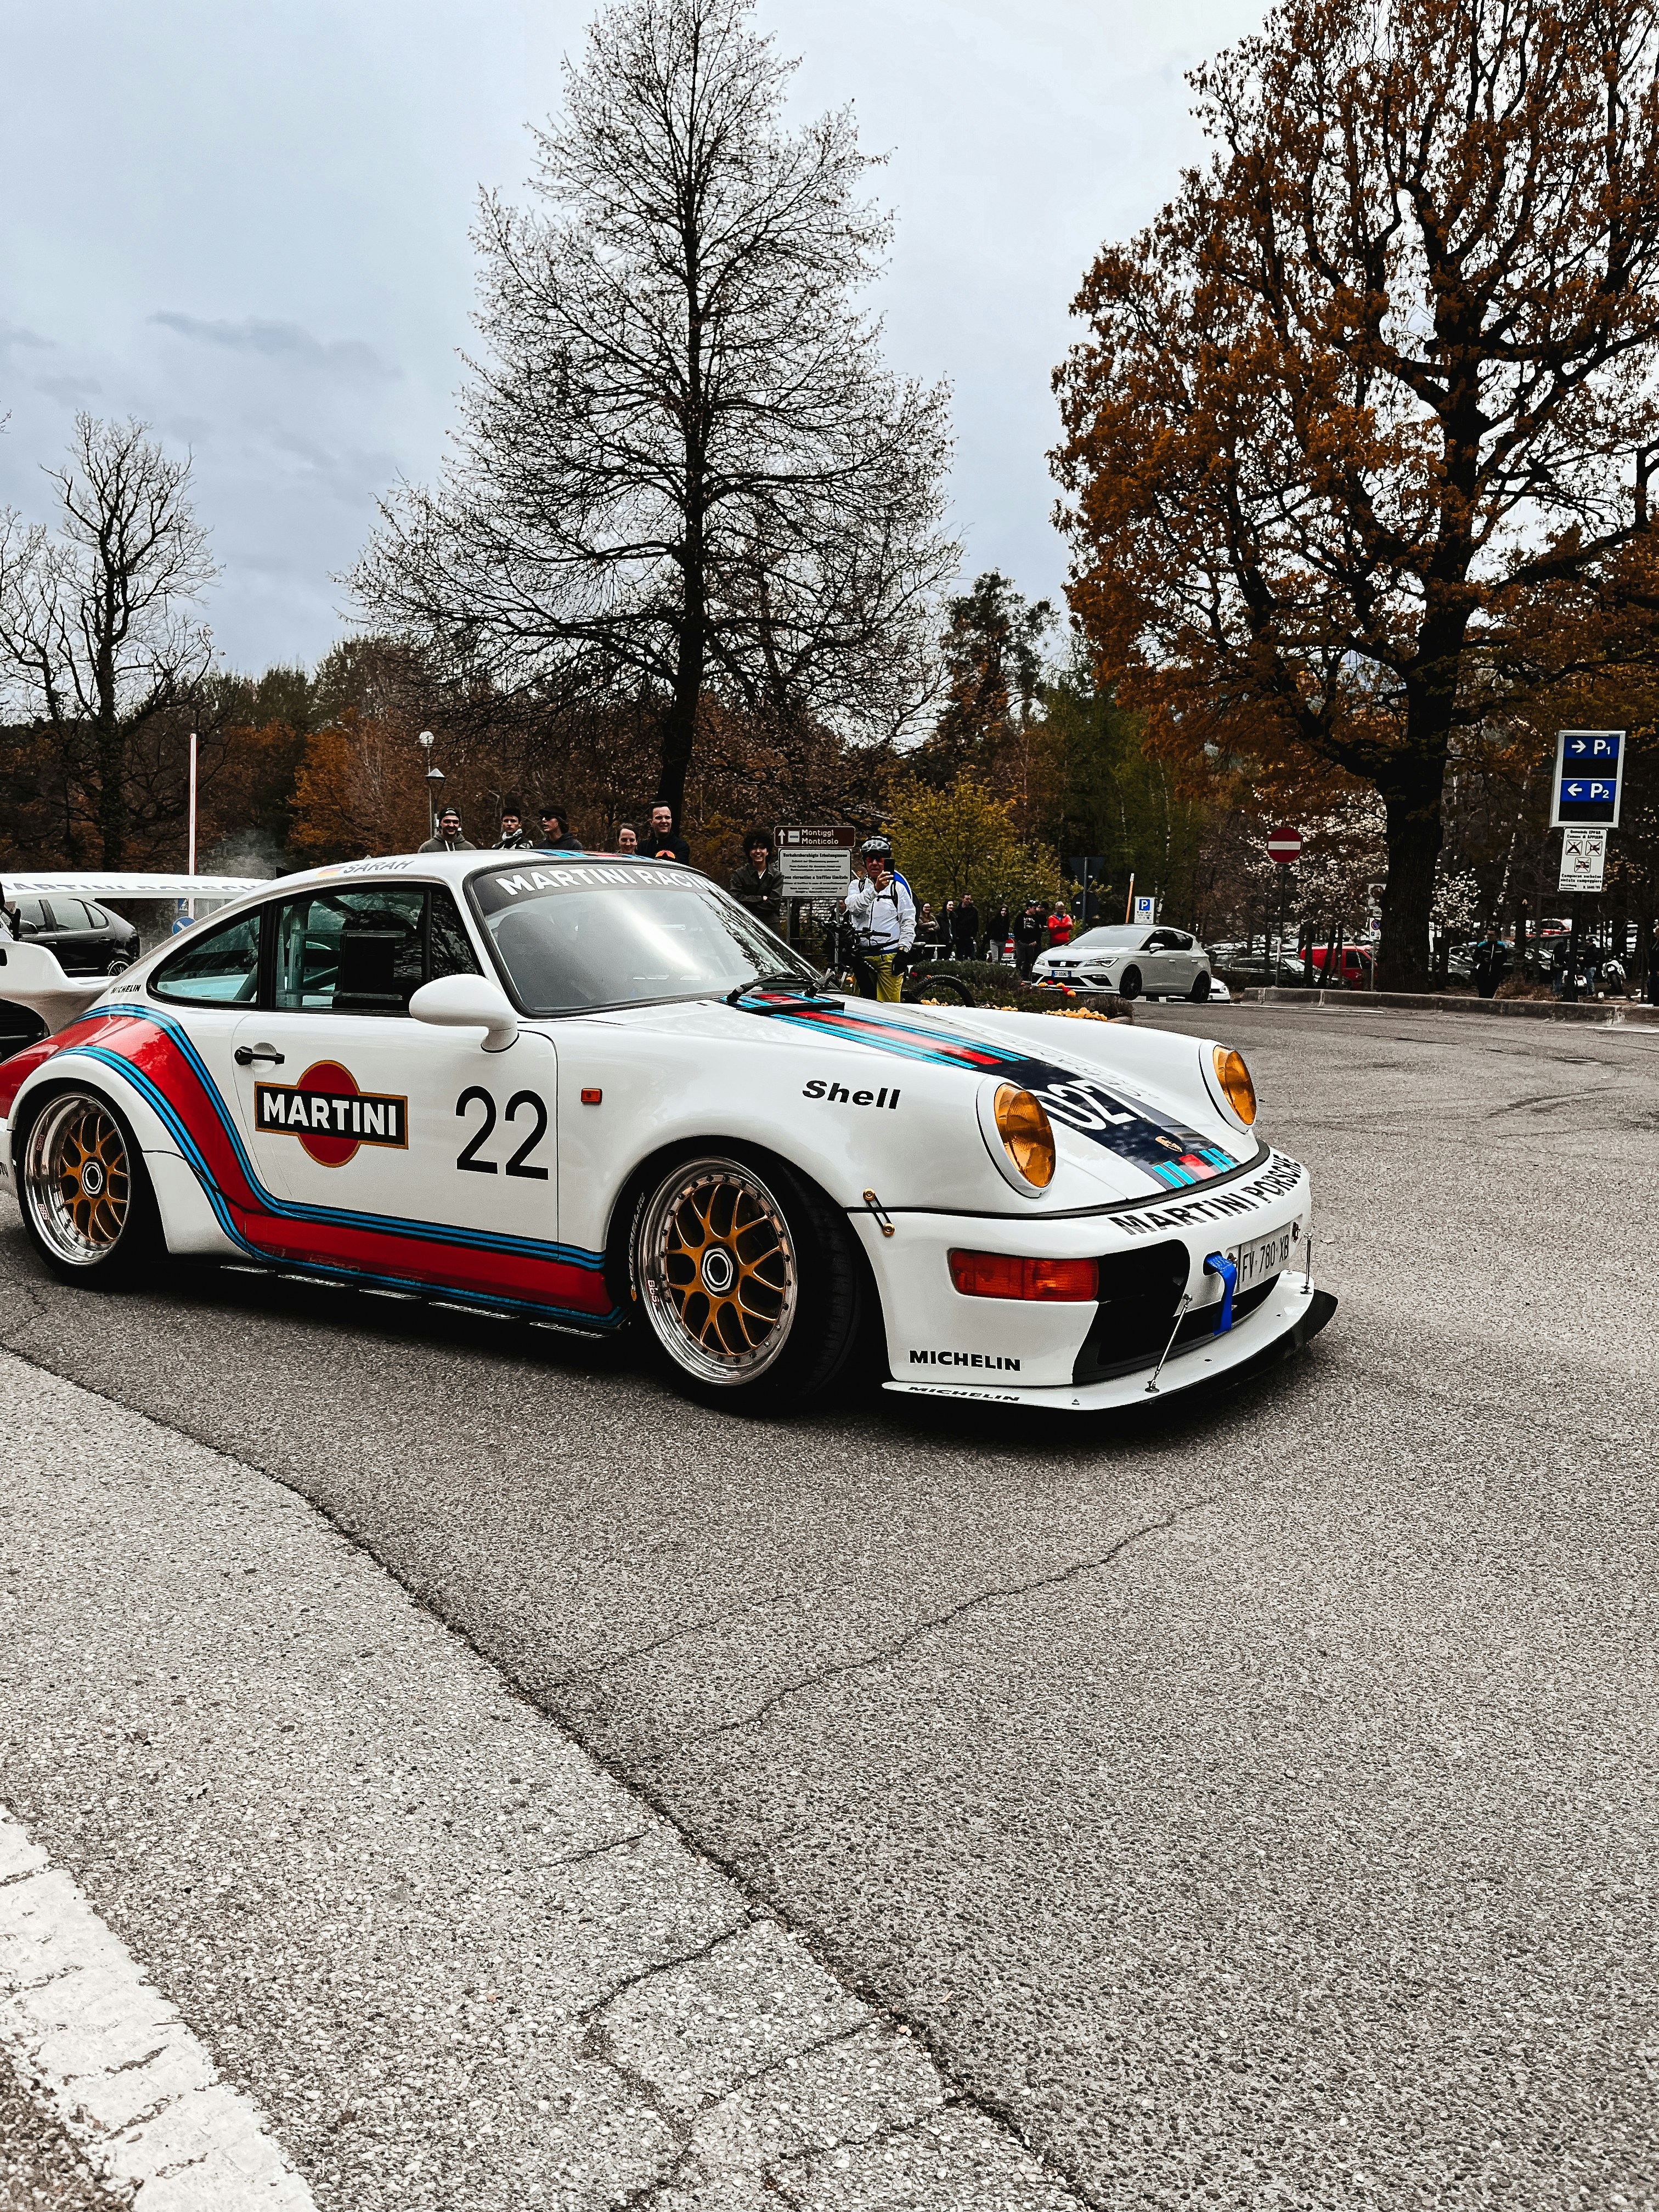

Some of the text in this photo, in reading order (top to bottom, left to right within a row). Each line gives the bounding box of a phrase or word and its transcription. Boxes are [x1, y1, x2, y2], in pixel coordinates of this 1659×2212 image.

[343, 860, 415, 874] SARAH
[495, 868, 637, 896] MARTINI
[803, 1080, 901, 1110] Shell
[263, 1092, 397, 1136] MARTINI
[455, 1086, 549, 1181] 22
[1108, 1154, 1302, 1235] MARTINI PORSCHE
[1242, 1234, 1289, 1282] FY 780 XB
[909, 1350, 1021, 1372] MICHELIN
[908, 1386, 1020, 1402] MICHELIN
